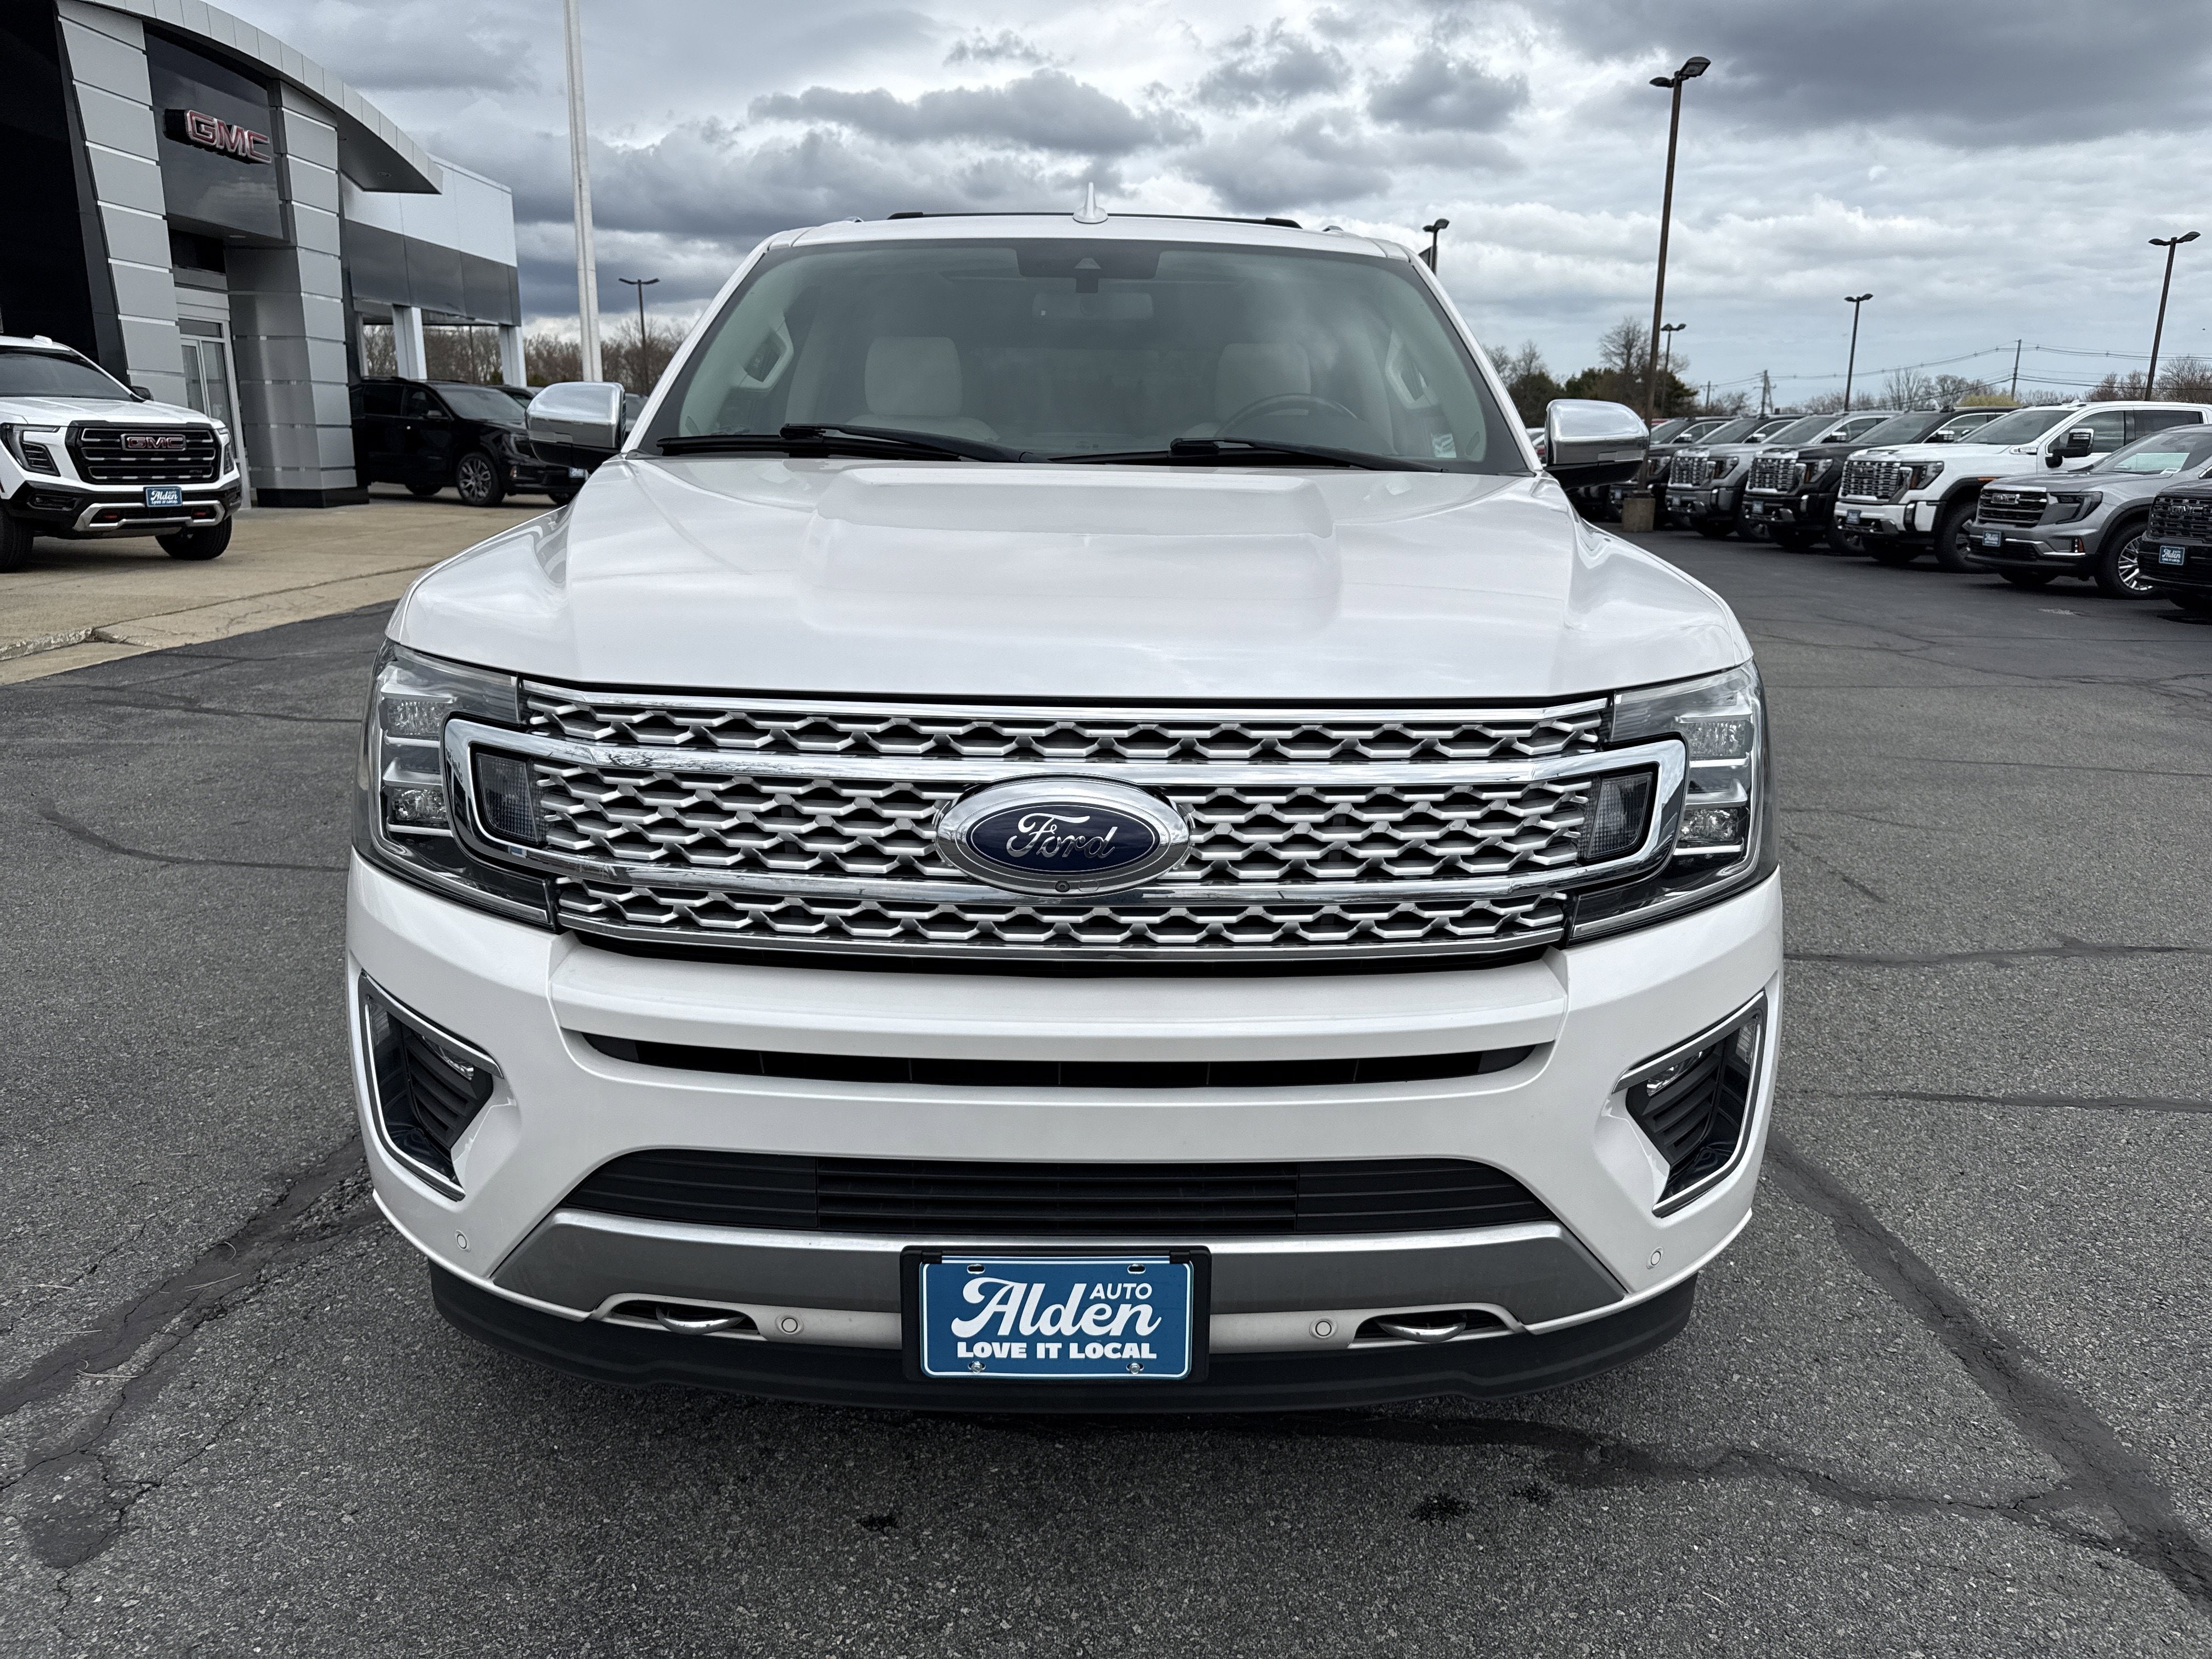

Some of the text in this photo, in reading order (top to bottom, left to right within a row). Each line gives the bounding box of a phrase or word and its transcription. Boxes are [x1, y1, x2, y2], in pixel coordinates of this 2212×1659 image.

[185, 110, 272, 164] GMC
[127, 437, 184, 449] GMC
[150, 490, 178, 501] Alden
[2162, 549, 2181, 559] Alden
[1006, 812, 1118, 859] Ford
[1089, 1282, 1153, 1300] AUTO
[951, 1277, 1163, 1338] Alden
[957, 1341, 1157, 1359] LOVE IT LOCAL
